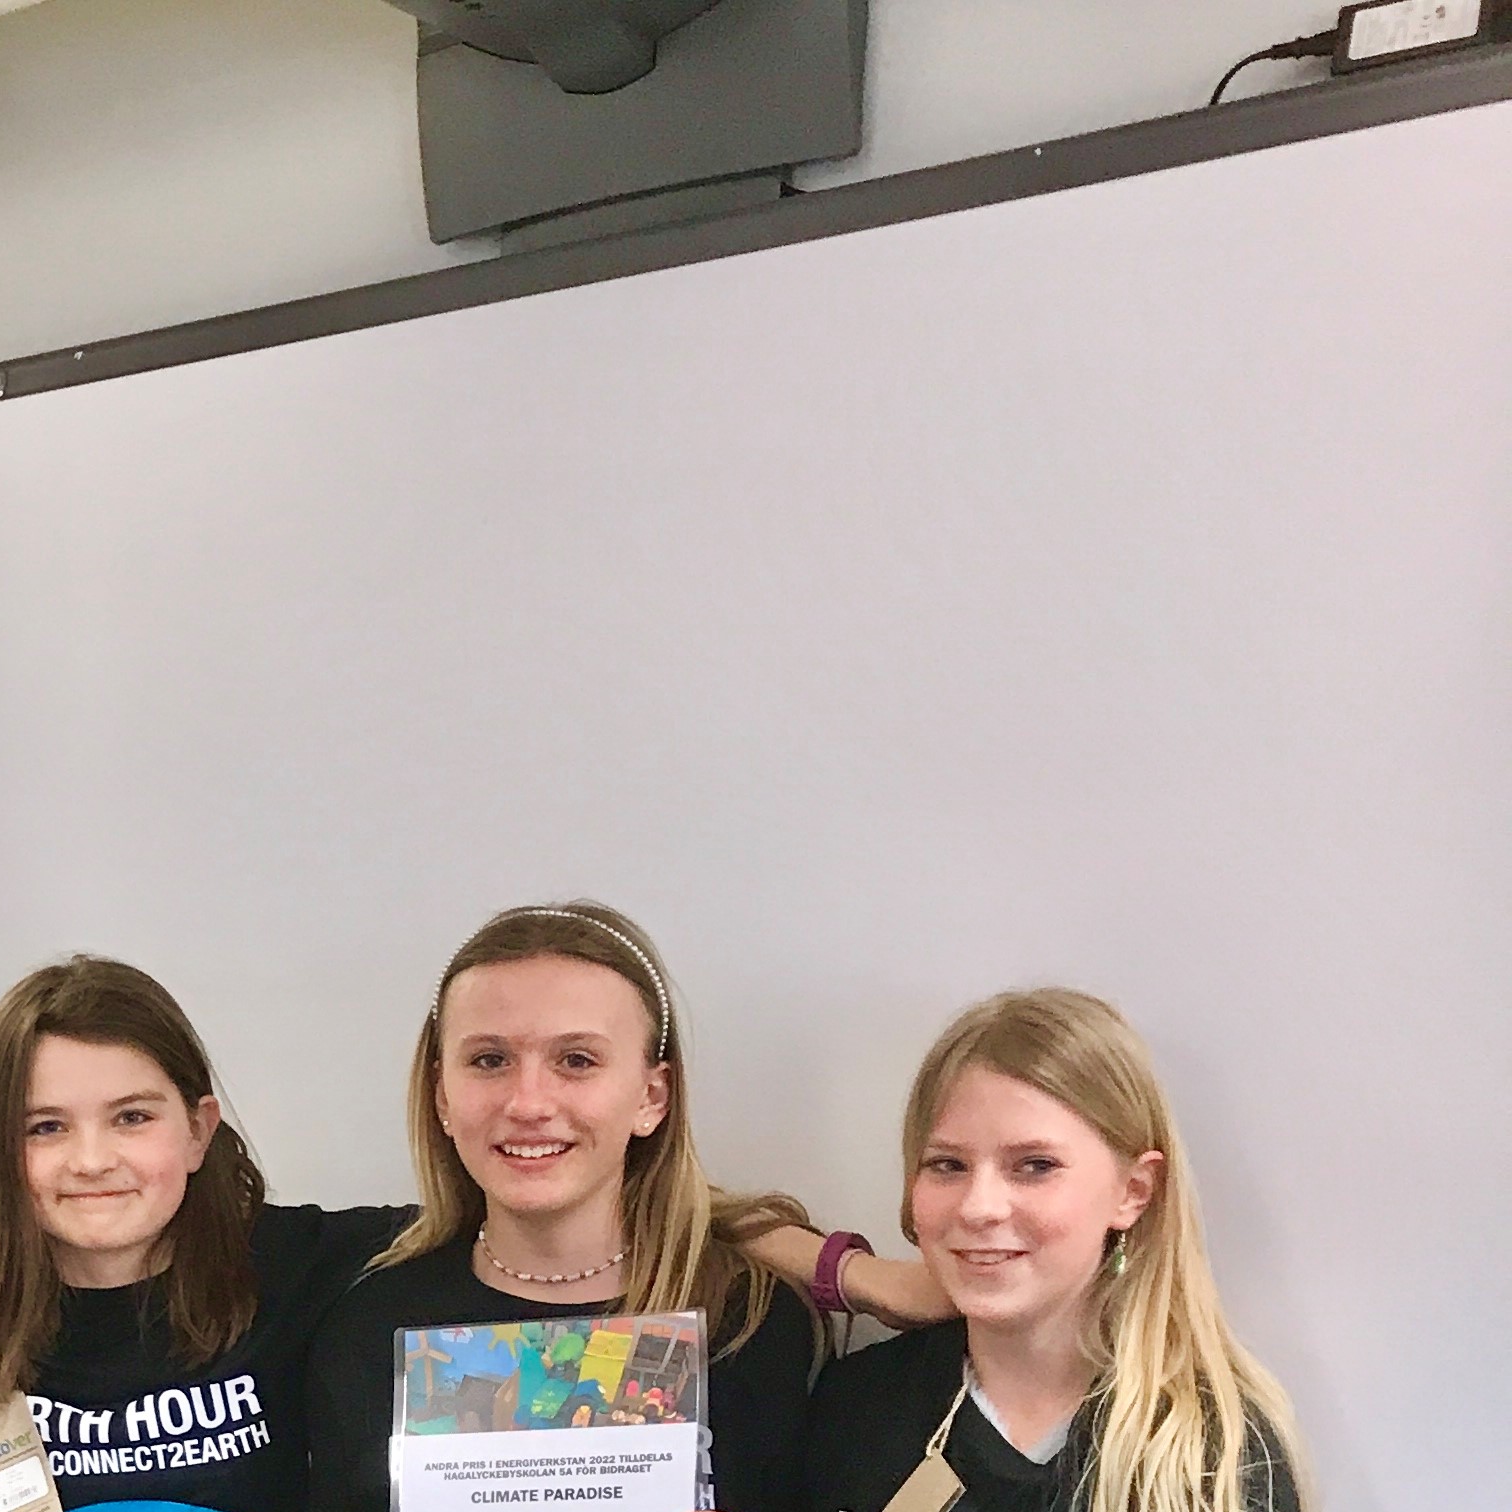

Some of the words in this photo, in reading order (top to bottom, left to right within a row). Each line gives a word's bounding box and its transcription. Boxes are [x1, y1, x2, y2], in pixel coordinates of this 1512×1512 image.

[125, 1374, 263, 1442] HOUR
[424, 1462, 460, 1472] ANDRA
[462, 1460, 487, 1470] PRIS
[489, 1460, 493, 1469] I
[495, 1456, 586, 1469] ENERGIVERKSTAN
[589, 1455, 617, 1465] 2022
[619, 1452, 673, 1464] TILLDELAS
[444, 1468, 556, 1481] HAGALYCKEBYSKOLAN
[559, 1467, 573, 1477] 5A
[600, 1463, 652, 1475] BIDRAGET
[470, 1489, 540, 1504] CLIMATE
[543, 1485, 624, 1501] PARADISE
